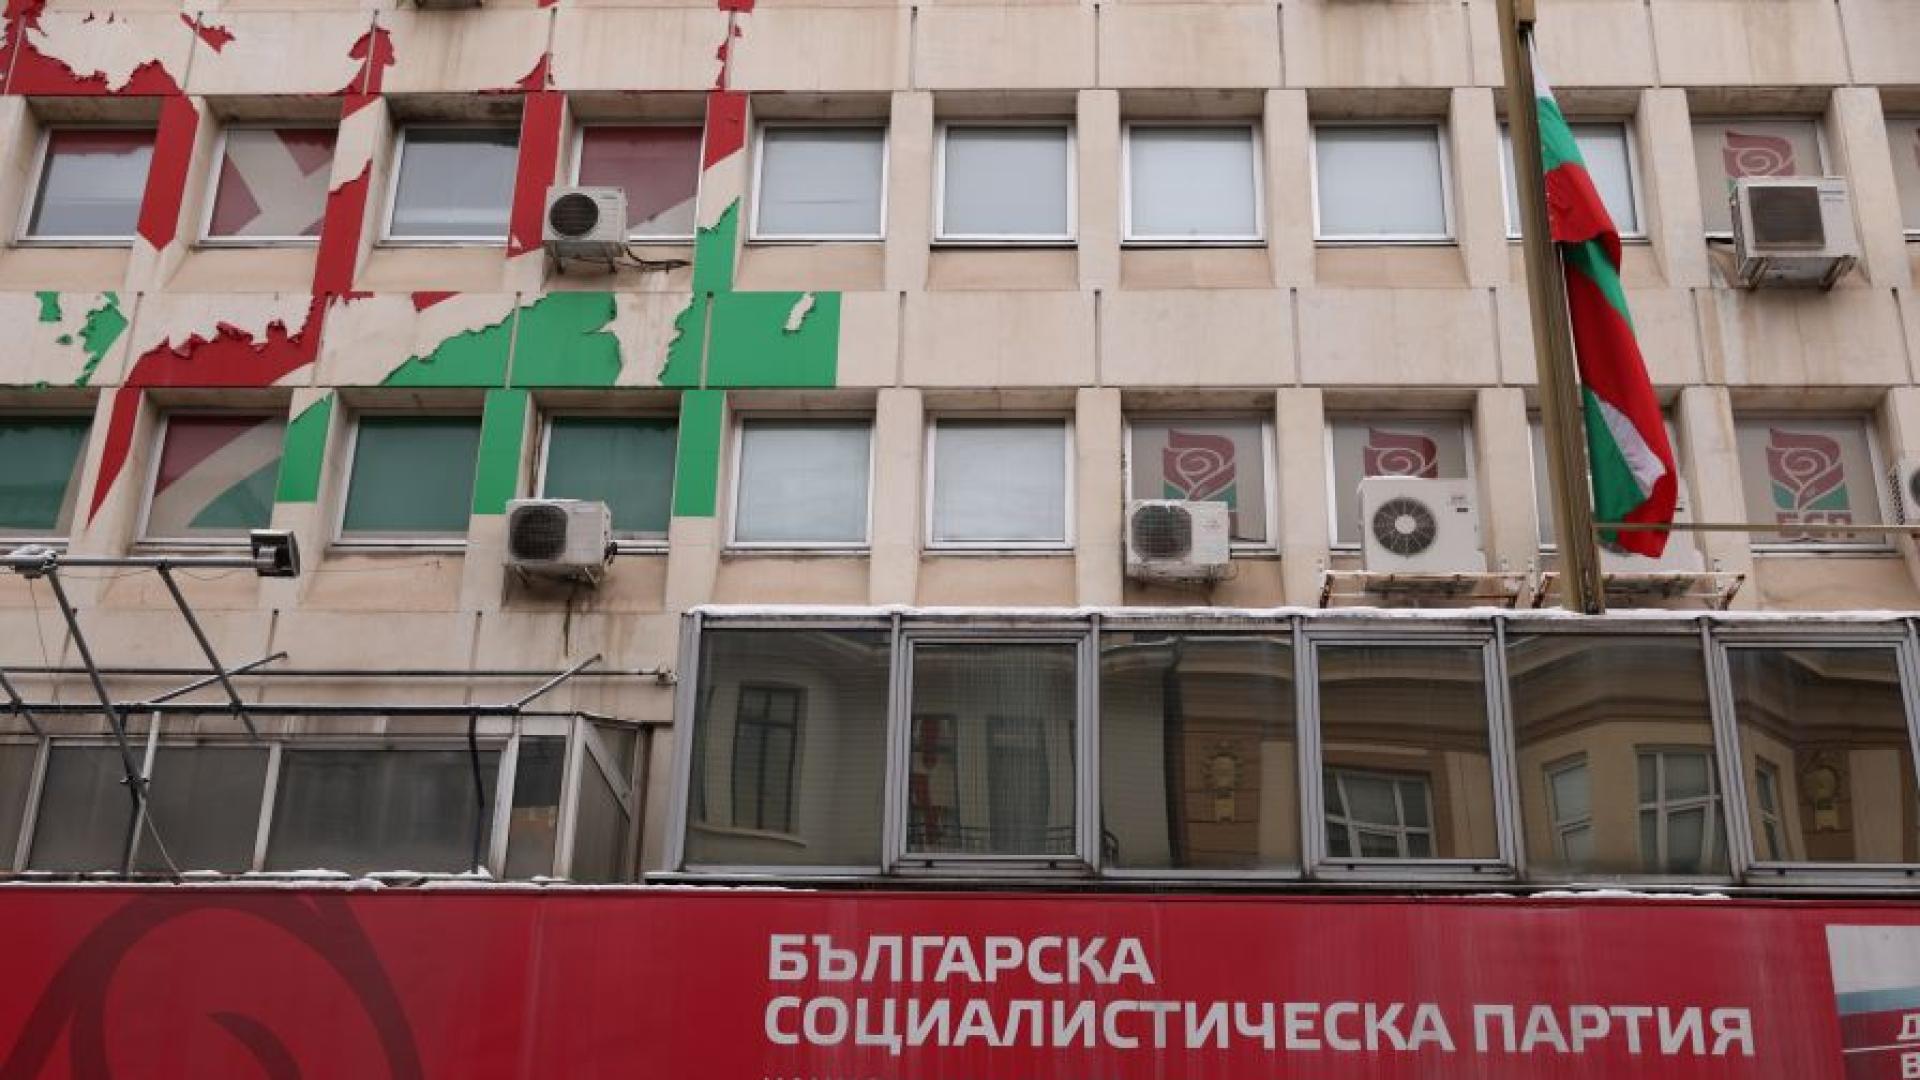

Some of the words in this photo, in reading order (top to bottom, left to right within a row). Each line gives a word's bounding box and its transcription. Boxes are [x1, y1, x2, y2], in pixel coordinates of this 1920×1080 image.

[769, 934, 1155, 984] БЪЛГАРСКА
[764, 996, 1455, 1056] СОЦИАЛИСТИЧЕСКА
[1473, 1004, 1755, 1056] ПАРТИЯ
